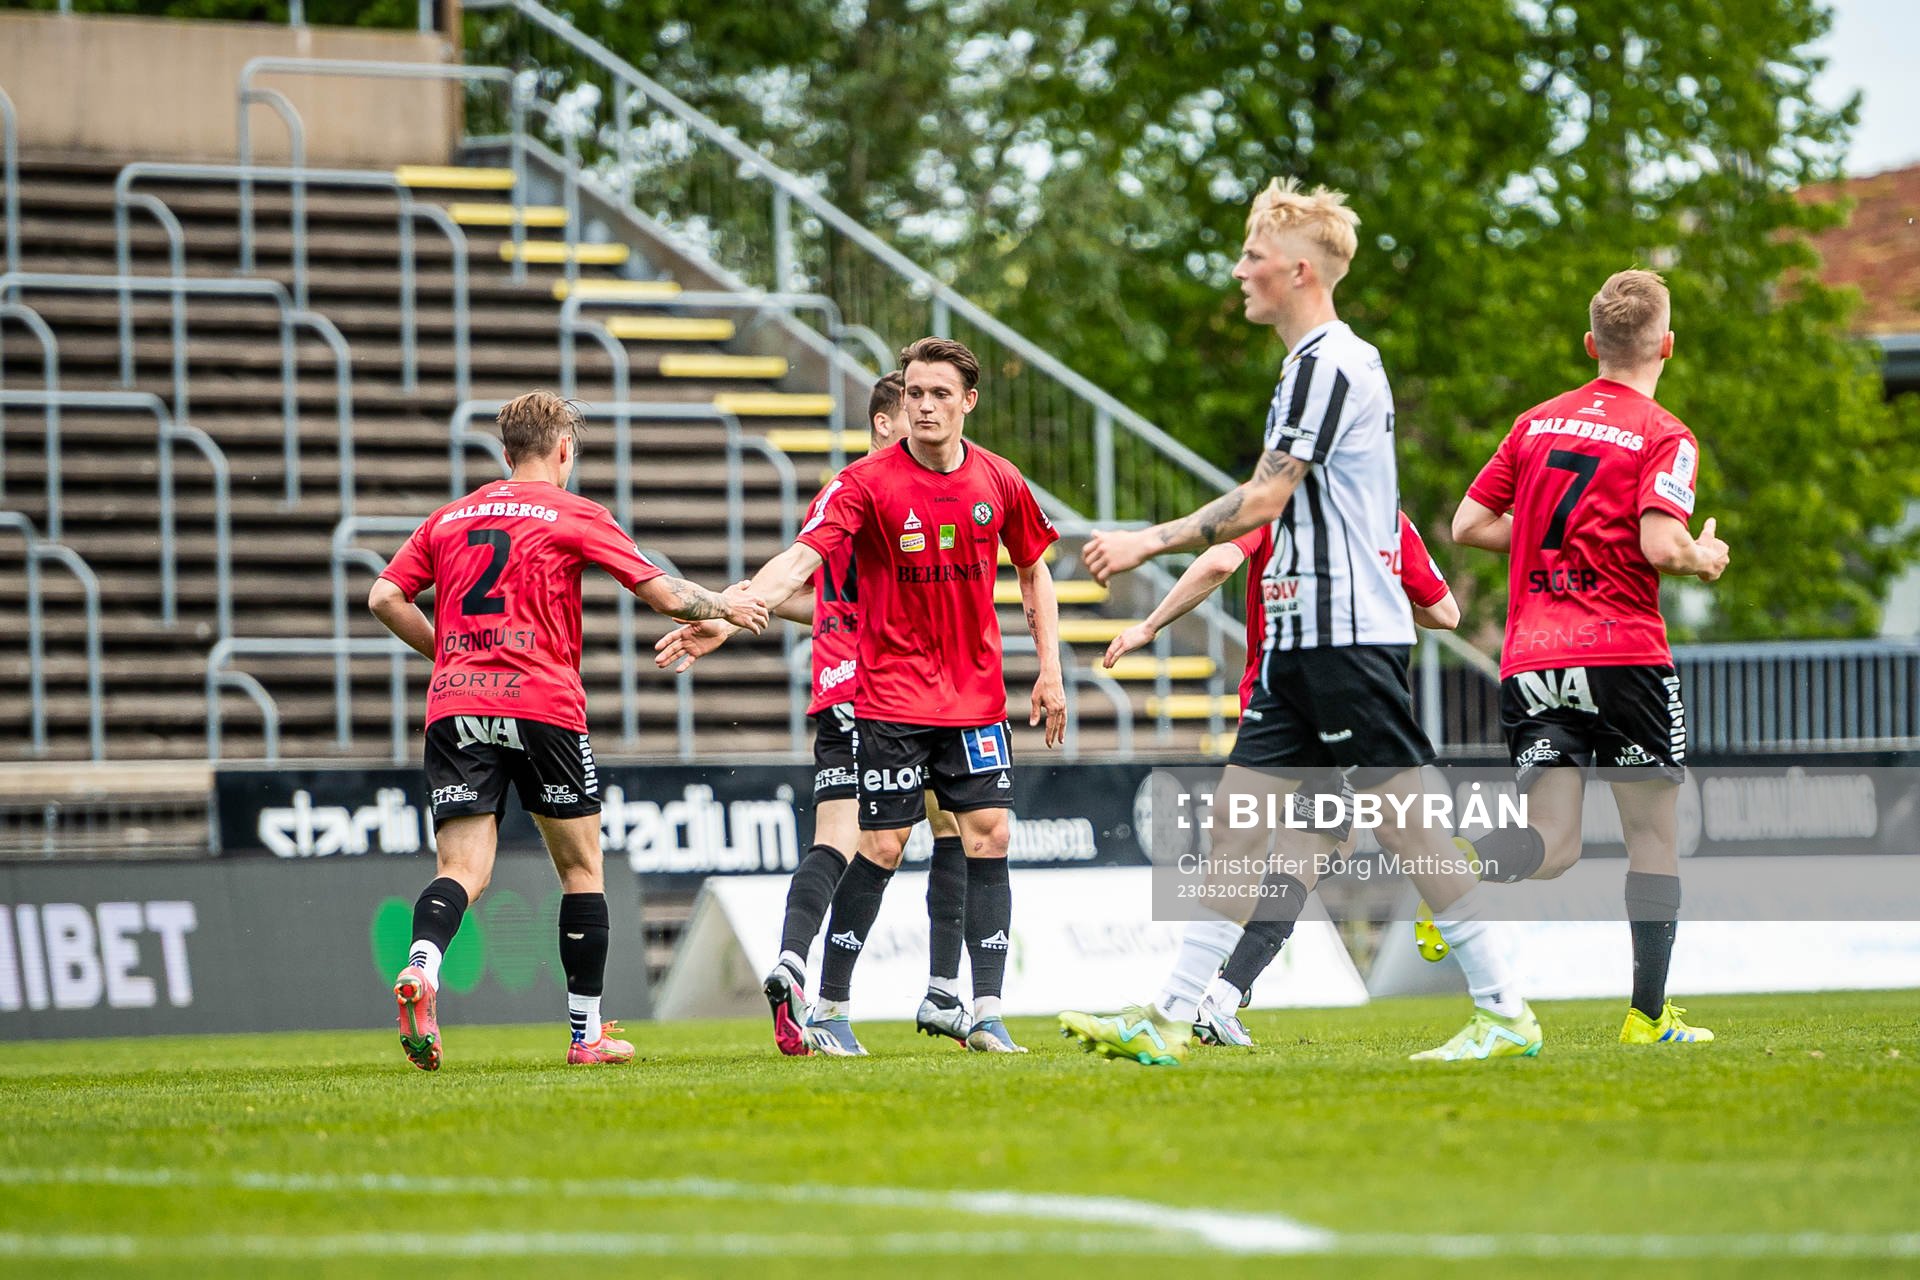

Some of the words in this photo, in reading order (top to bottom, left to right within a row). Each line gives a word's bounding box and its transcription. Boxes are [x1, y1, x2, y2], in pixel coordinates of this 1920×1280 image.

[1541, 449, 1600, 551] 7
[461, 529, 512, 616] 2
[600, 784, 799, 873] tadium
[870, 801, 878, 815] 5
